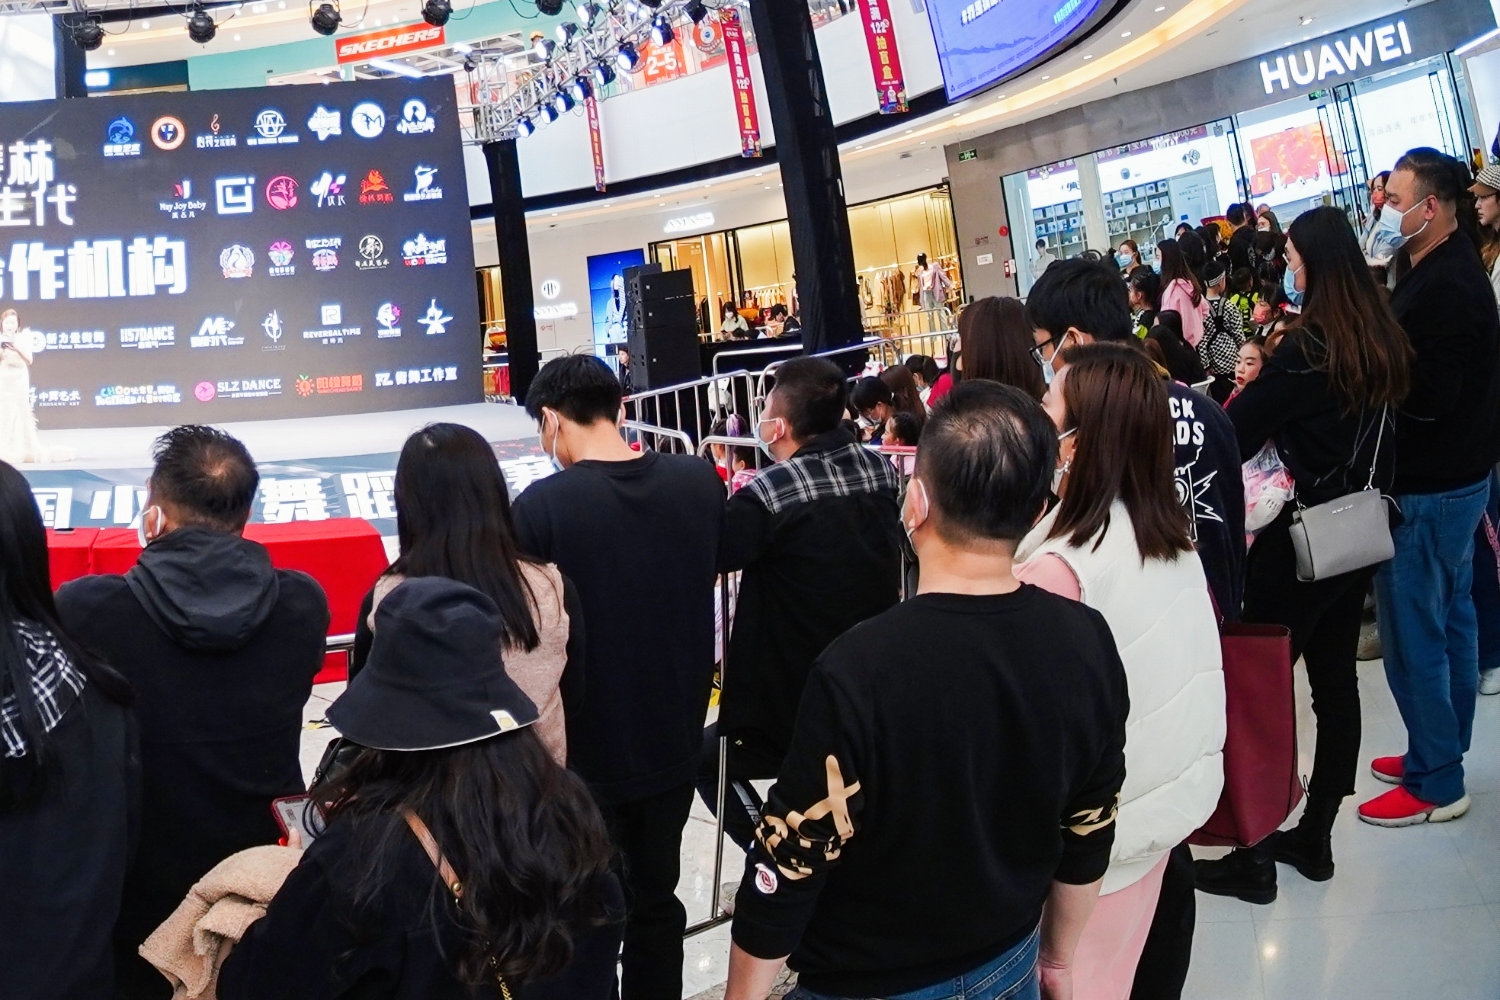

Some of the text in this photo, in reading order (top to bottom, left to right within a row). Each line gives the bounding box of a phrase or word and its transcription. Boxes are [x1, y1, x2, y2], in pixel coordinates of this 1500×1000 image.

[339, 27, 442, 56] SKECHERS
[1259, 21, 1412, 94] HUAWEI
[218, 379, 281, 392] SLZ DANCE
